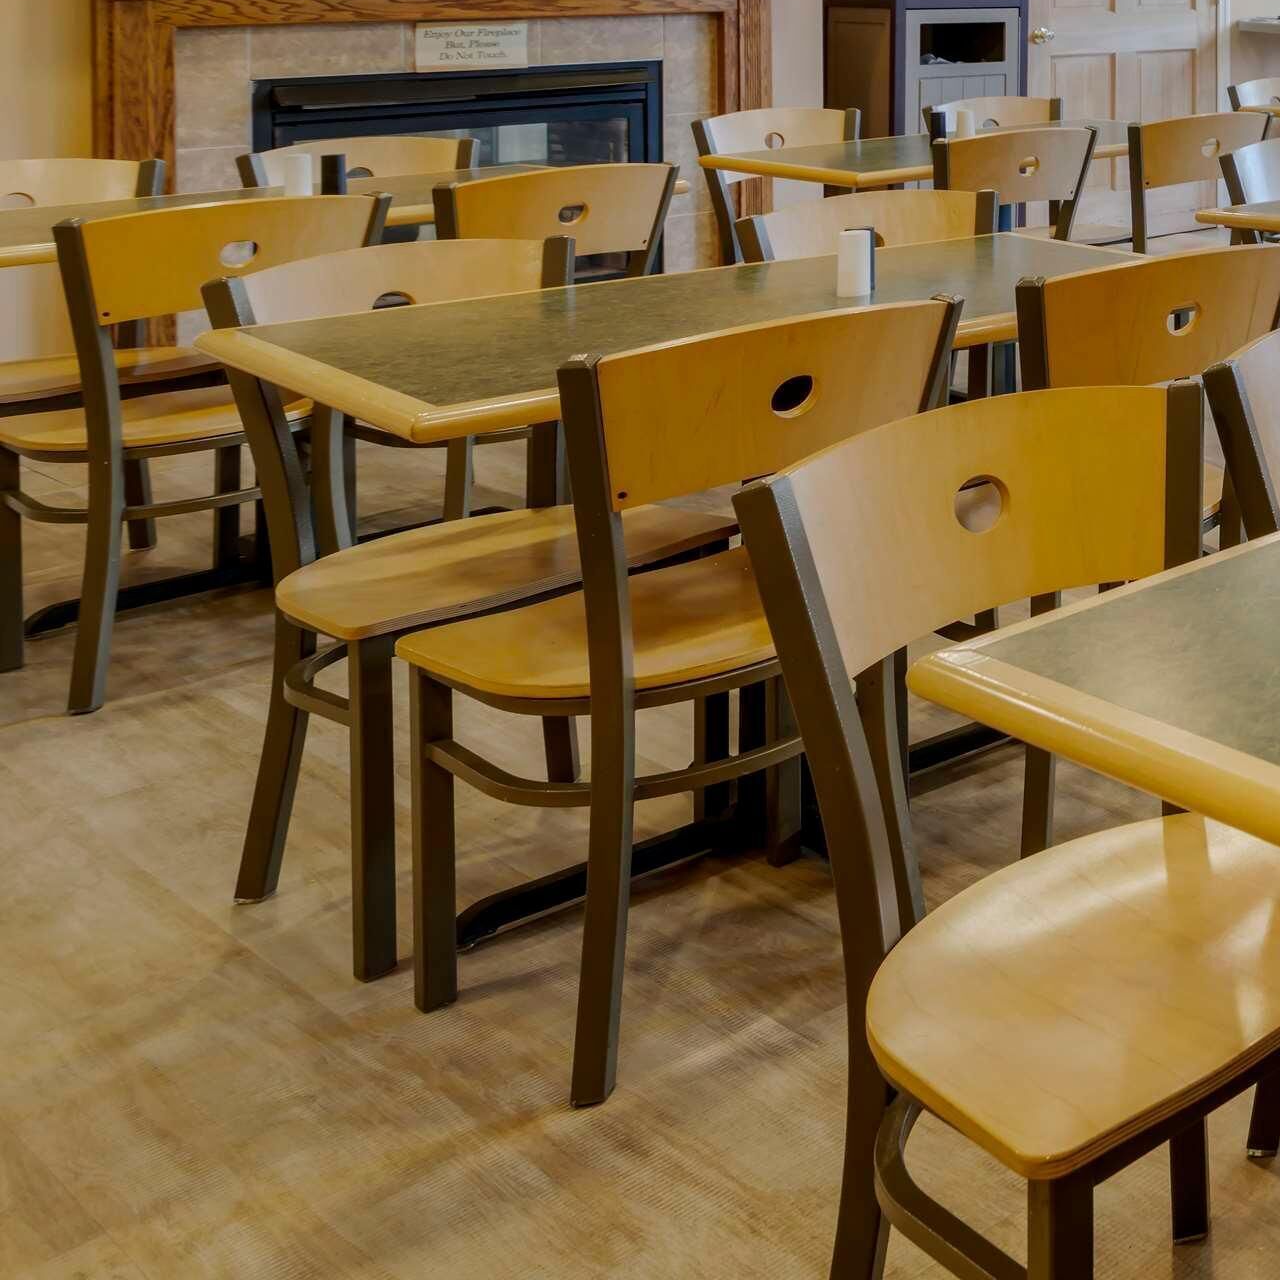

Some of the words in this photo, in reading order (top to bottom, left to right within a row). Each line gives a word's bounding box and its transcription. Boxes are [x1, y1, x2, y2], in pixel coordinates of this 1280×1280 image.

[424, 30, 452, 40] Enjoy
[455, 29, 474, 38] Our
[477, 27, 521, 38] Fireplace
[469, 40, 500, 49] Please
[440, 52, 454, 60] Do
[456, 50, 473, 60] Not
